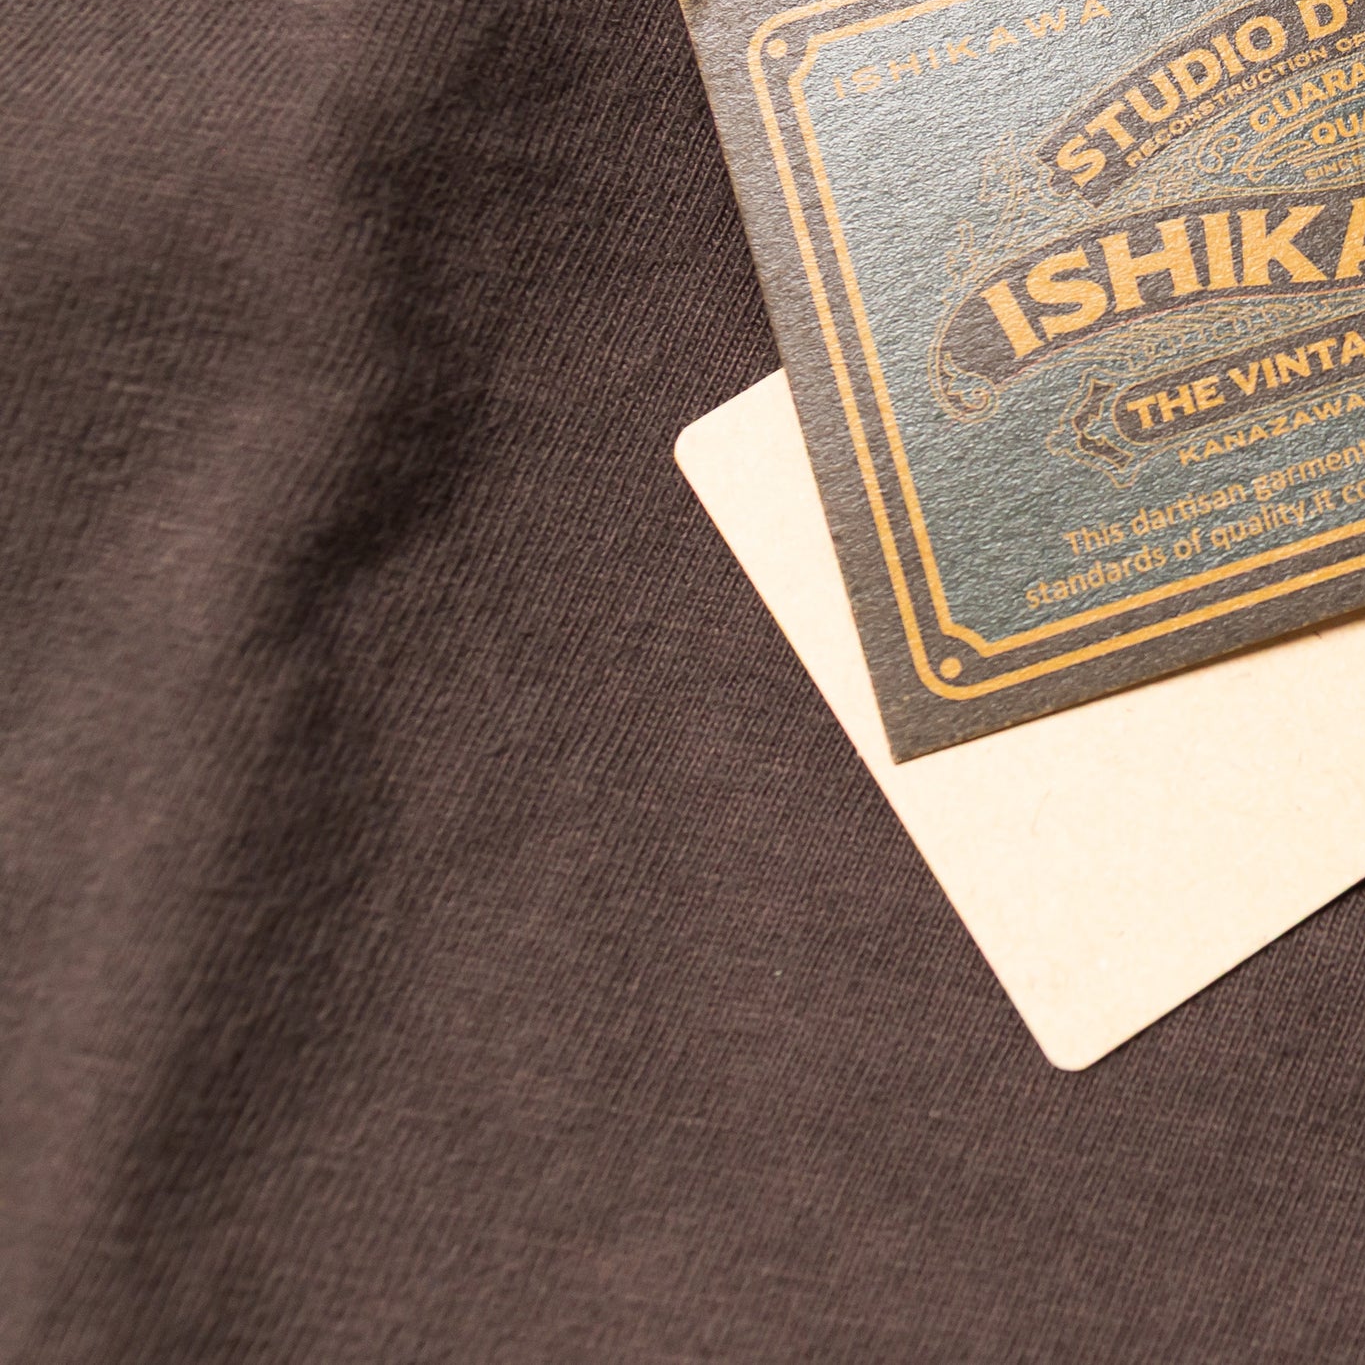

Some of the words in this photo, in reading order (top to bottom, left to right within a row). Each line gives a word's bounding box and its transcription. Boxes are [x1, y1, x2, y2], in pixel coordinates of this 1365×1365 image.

[1056, 14, 1288, 188] STUDIO
[1124, 45, 1329, 168] RECONSTRUCTION
[1126, 375, 1227, 431] THE
[1064, 524, 1125, 557] This
[1130, 481, 1248, 536] dartisan
[1024, 544, 1167, 610] standards
[1173, 531, 1205, 561] of
